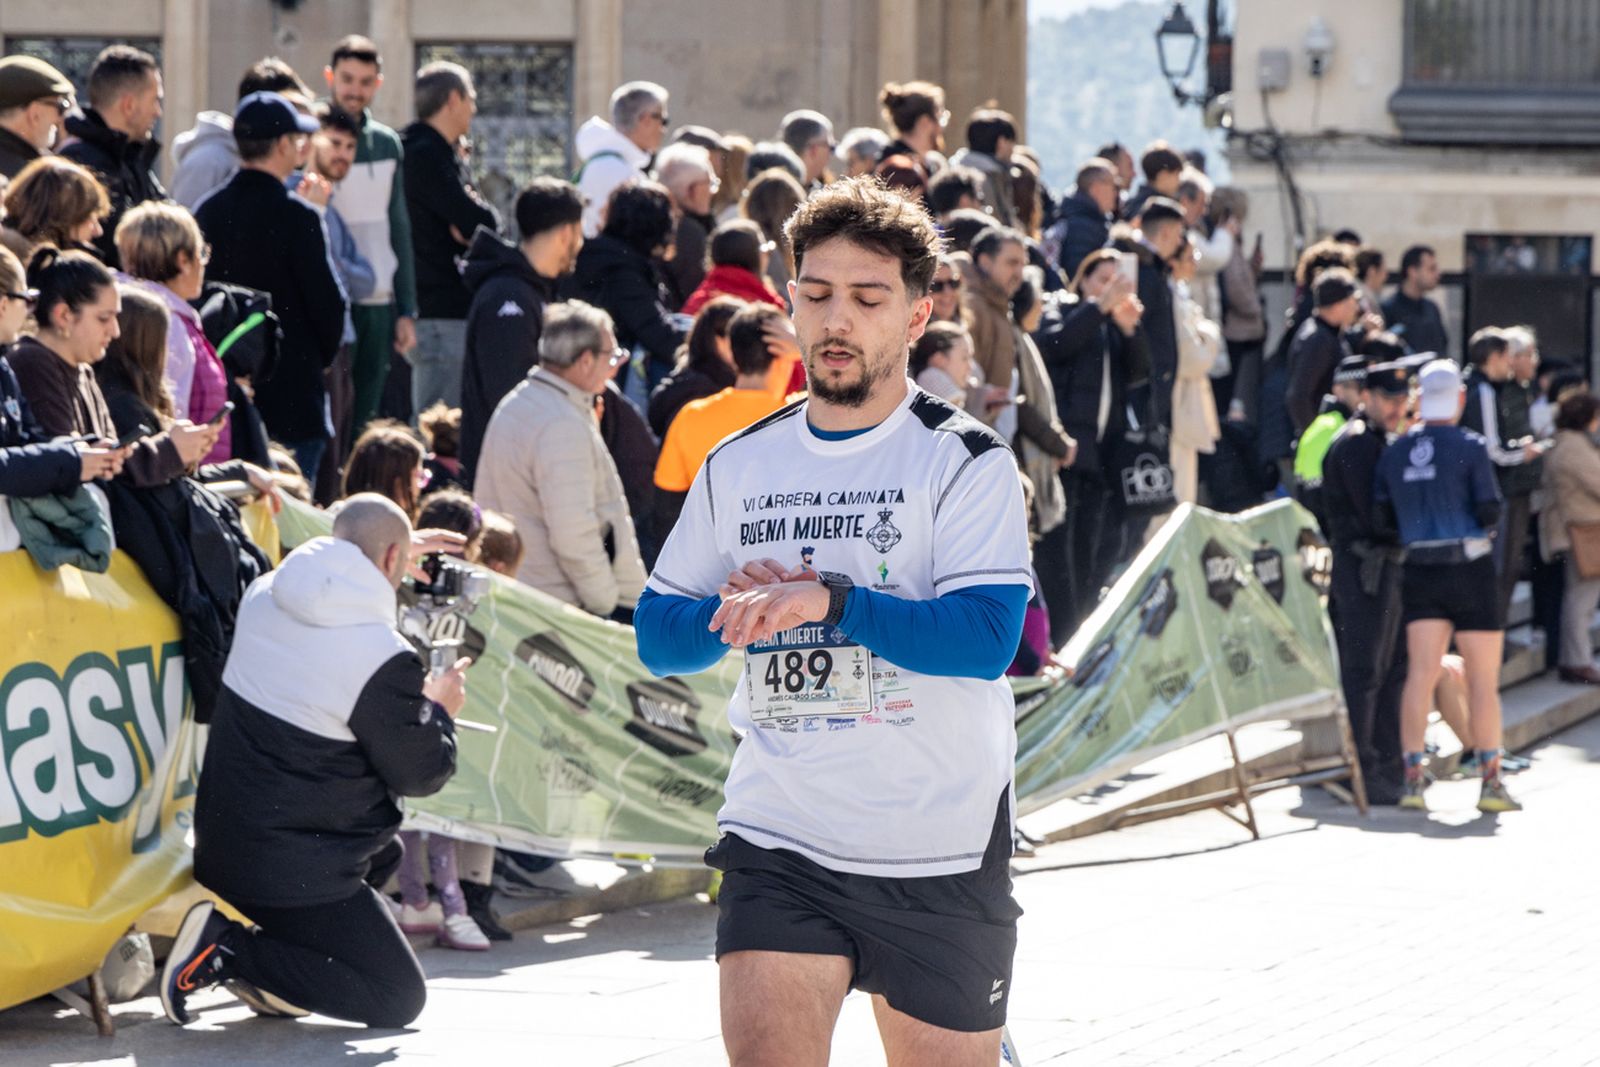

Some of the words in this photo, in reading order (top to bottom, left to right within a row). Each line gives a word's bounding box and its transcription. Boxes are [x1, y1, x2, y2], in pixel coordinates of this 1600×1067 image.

[743, 498, 755, 512] VI
[758, 491, 822, 510] CARRERA
[827, 488, 905, 506] CAMINATA
[740, 518, 786, 546] BUENA
[793, 514, 865, 540] MUERTE
[781, 627, 825, 645] MUERTE
[764, 649, 833, 693] 489
[0, 650, 208, 845] asy
